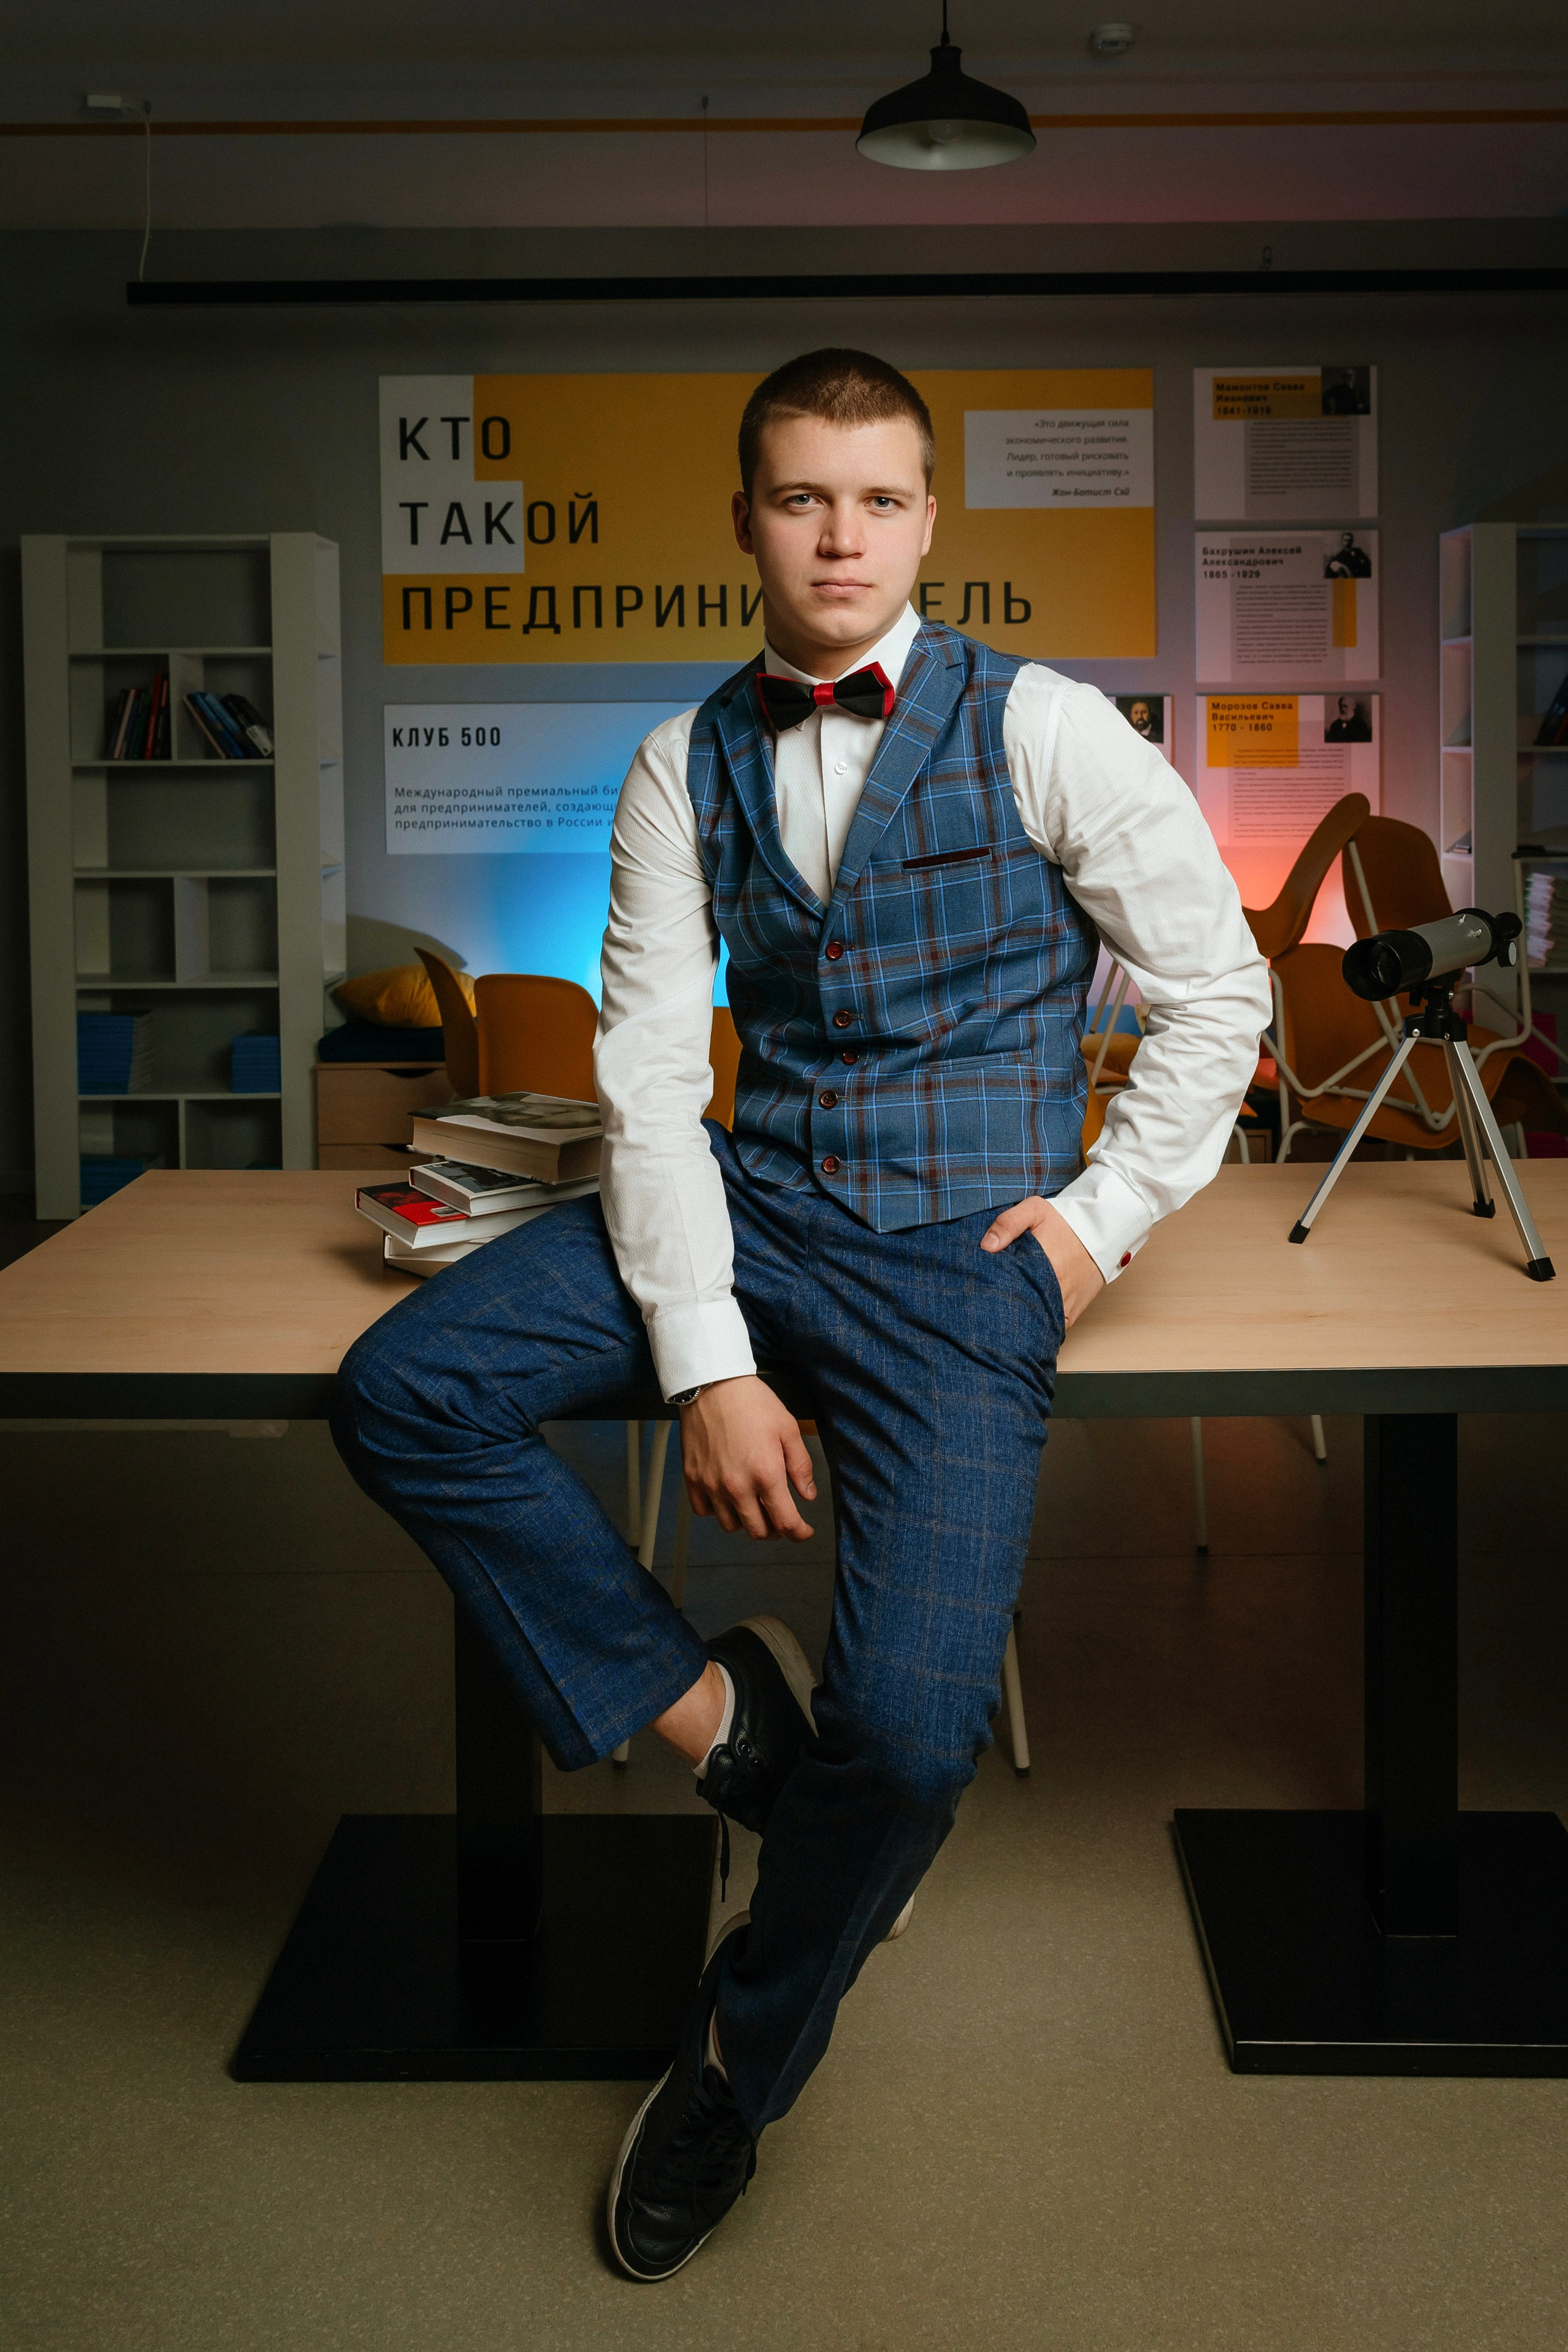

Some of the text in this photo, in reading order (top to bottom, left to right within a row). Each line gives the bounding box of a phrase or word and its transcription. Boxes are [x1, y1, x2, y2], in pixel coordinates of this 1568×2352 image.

[1273, 382, 1305, 391] Савва
[1058, 421, 1106, 429] движущая
[399, 416, 510, 460] КТО
[1082, 453, 1129, 461] рисковать
[1114, 488, 1129, 496] Сэй
[399, 492, 598, 545] ТАКОЙ
[1202, 547, 1254, 556] Бахрушин
[402, 580, 1032, 635] ПРЕДПРИНИЕЛЬ
[1250, 723, 1272, 731] 1860
[393, 727, 500, 747] КЛУБ 500
[395, 784, 620, 799] Международный премиальный би
[394, 802, 616, 815] для предпринимателей, создающ
[396, 820, 541, 831] предпринимательство
[558, 817, 602, 827] России
